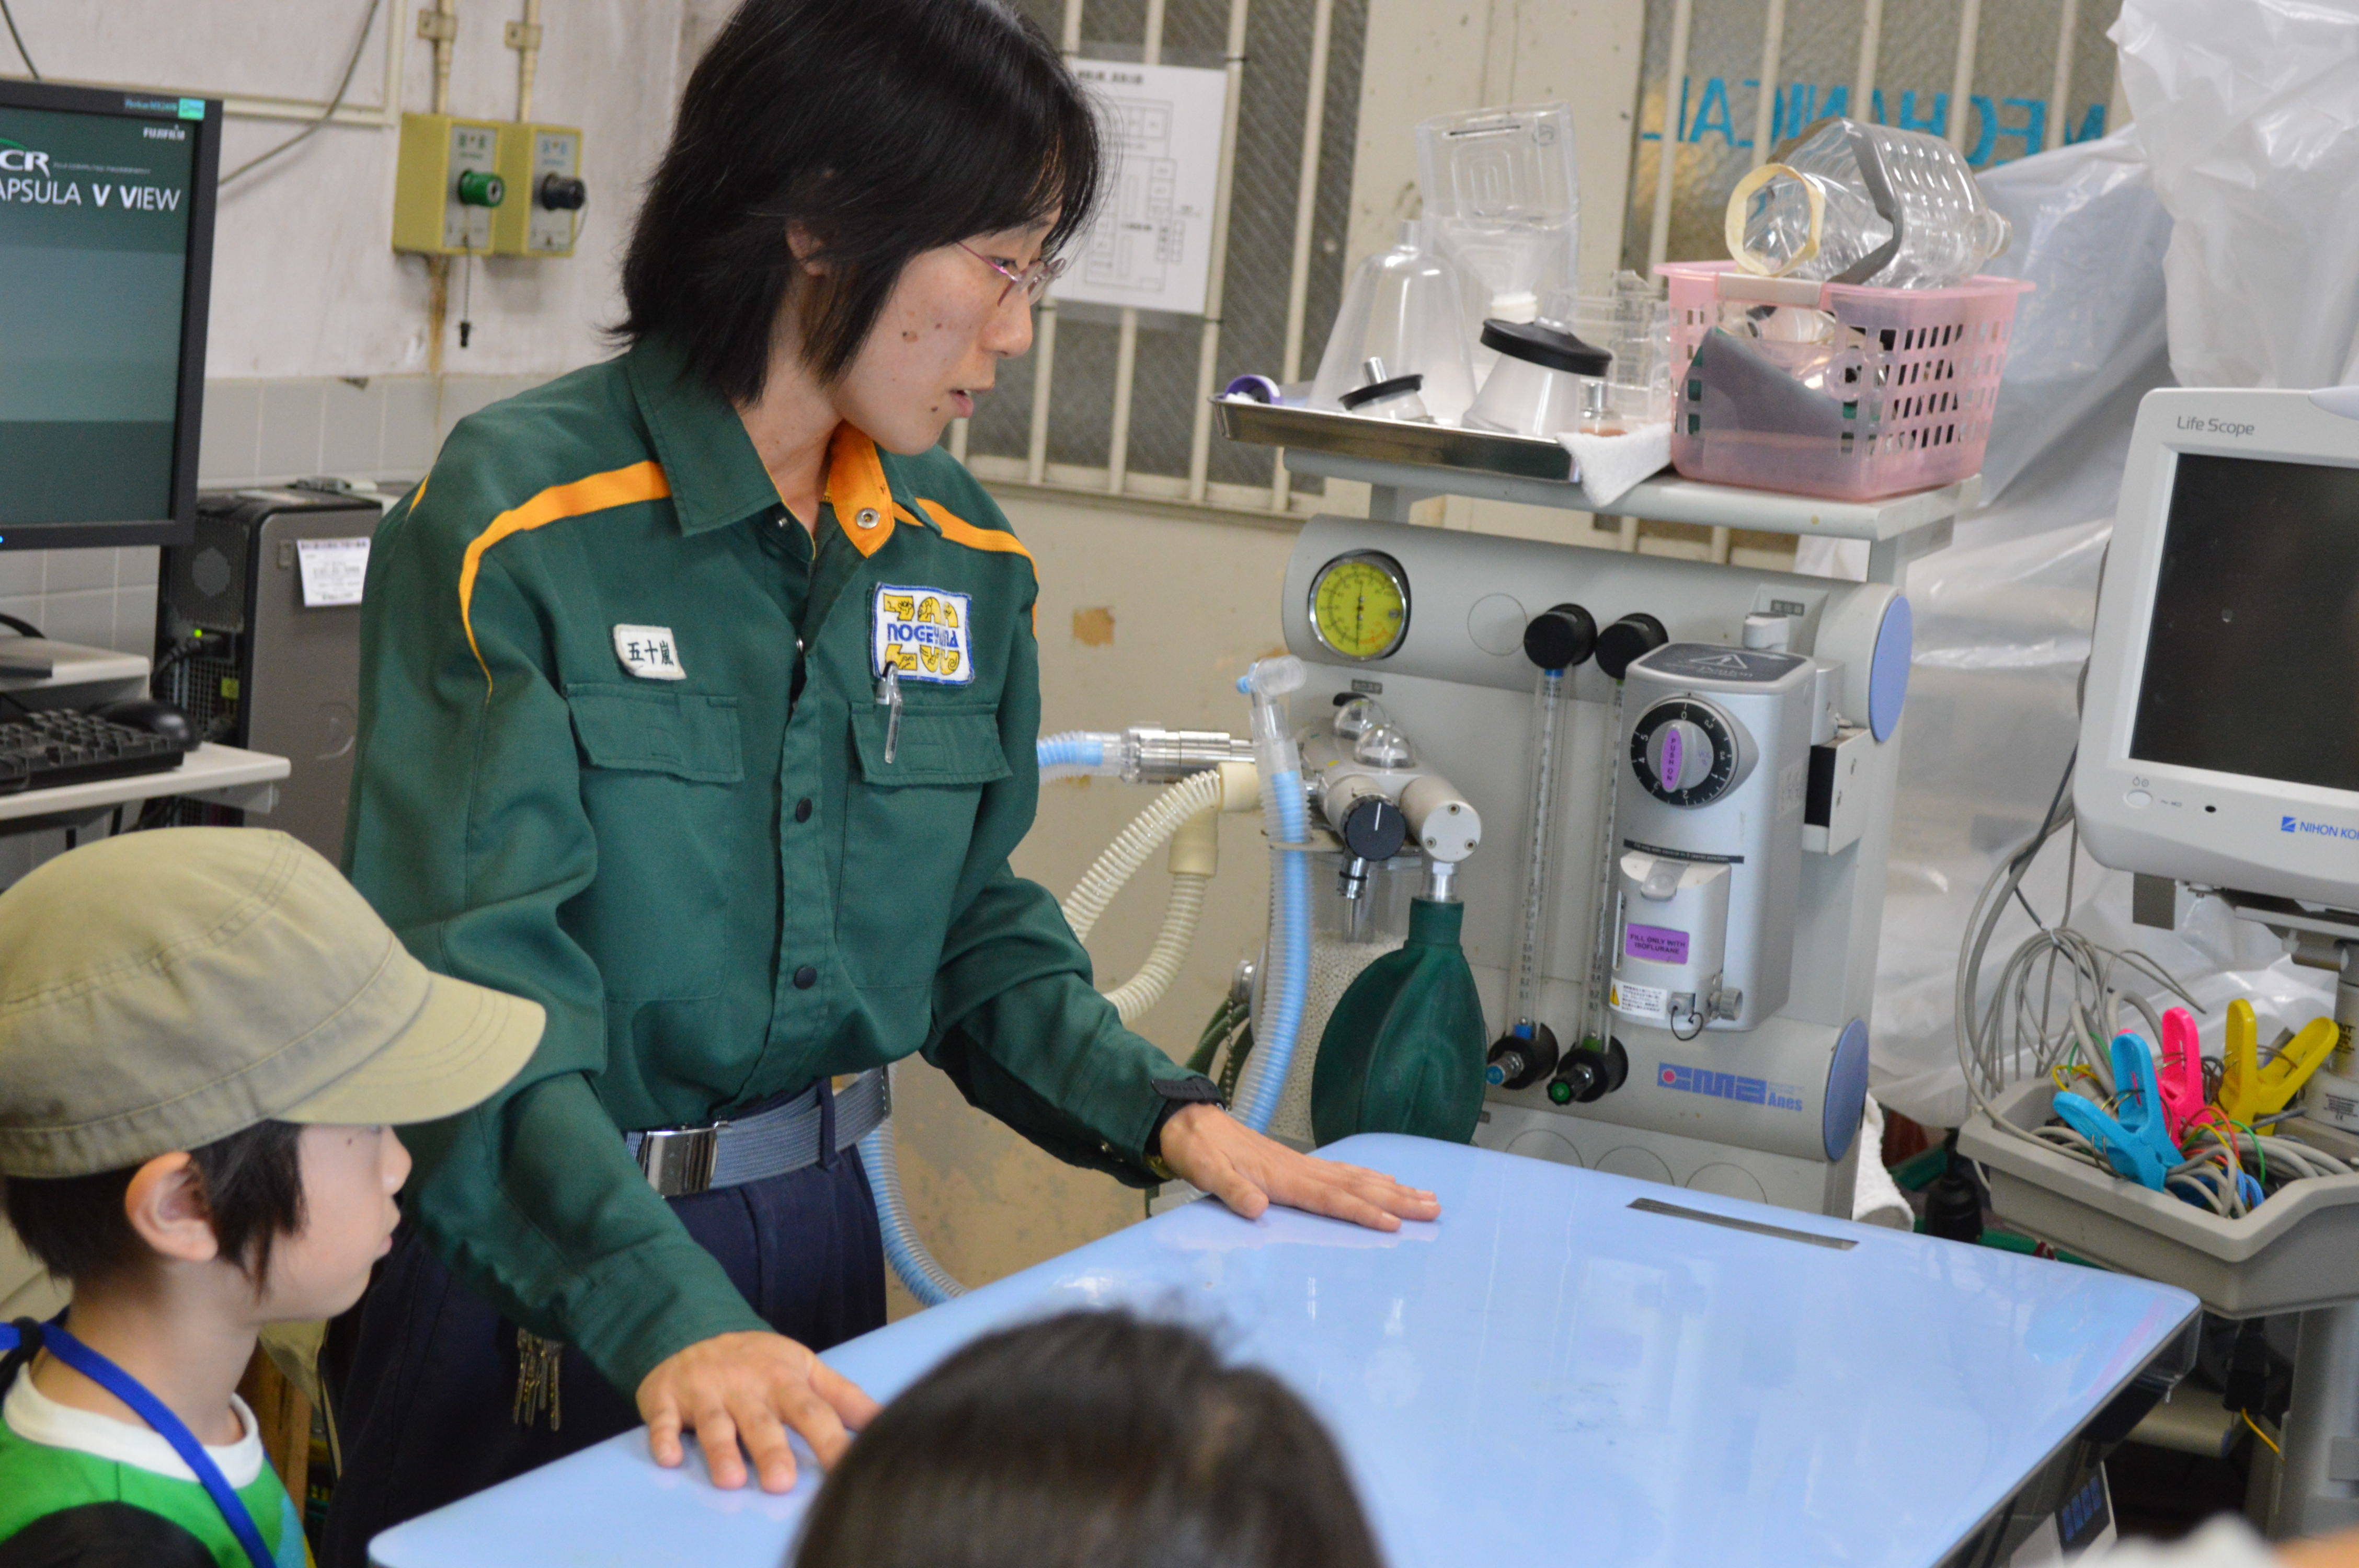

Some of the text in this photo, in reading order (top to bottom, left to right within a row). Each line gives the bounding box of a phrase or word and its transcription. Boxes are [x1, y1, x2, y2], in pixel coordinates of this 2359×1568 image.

[92, 183, 111, 207] V
[119, 185, 181, 211] VIEW
[2177, 416, 2255, 438] Life Scope
[627, 639, 674, 666] 五十嵐
[2300, 821, 2339, 836] NIHON
[1634, 941, 1679, 955] ISOFLURANE
[1646, 936, 1665, 945] ONLY
[1666, 940, 1686, 948] WITH
